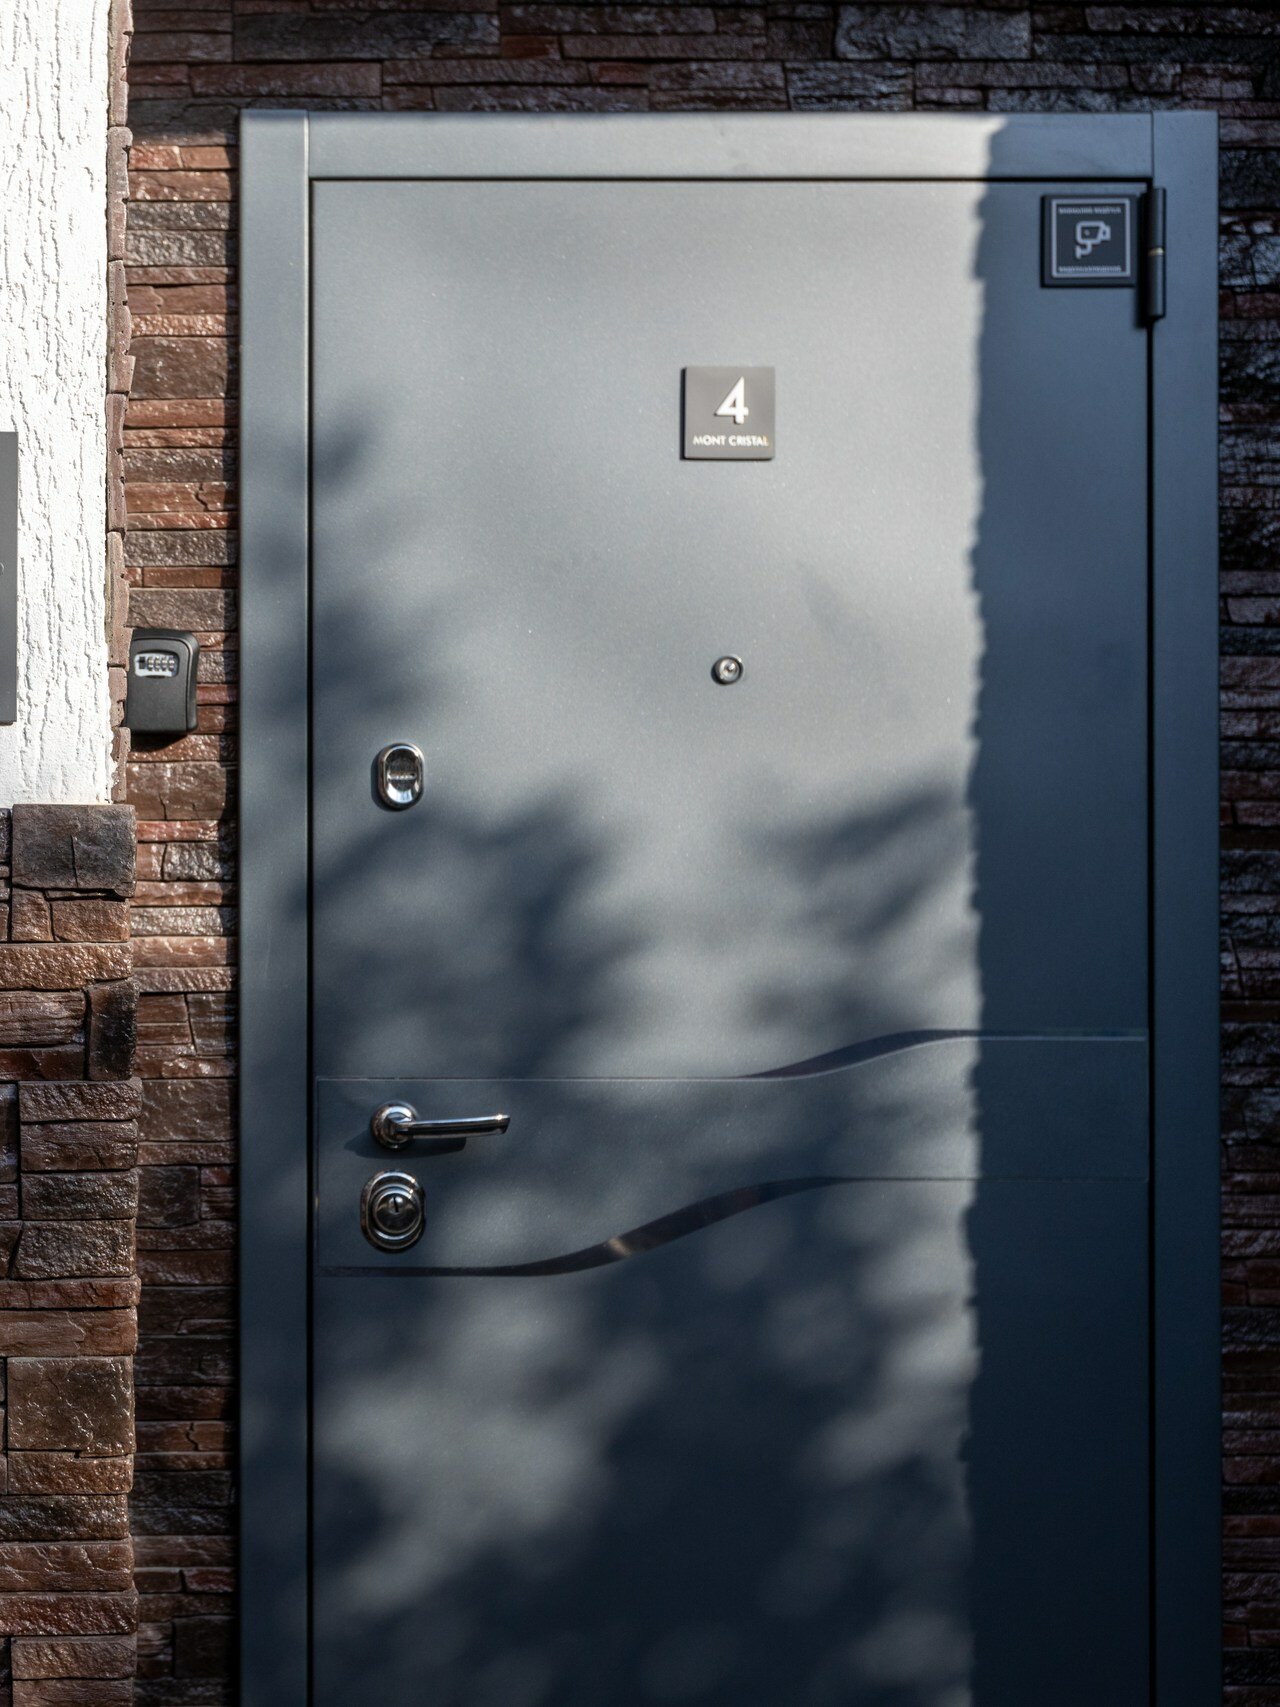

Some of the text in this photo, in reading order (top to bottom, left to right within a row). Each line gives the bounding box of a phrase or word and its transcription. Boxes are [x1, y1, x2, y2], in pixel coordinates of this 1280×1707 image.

[714, 376, 749, 424] 4
[693, 435, 769, 447] MONT CRISTAL
